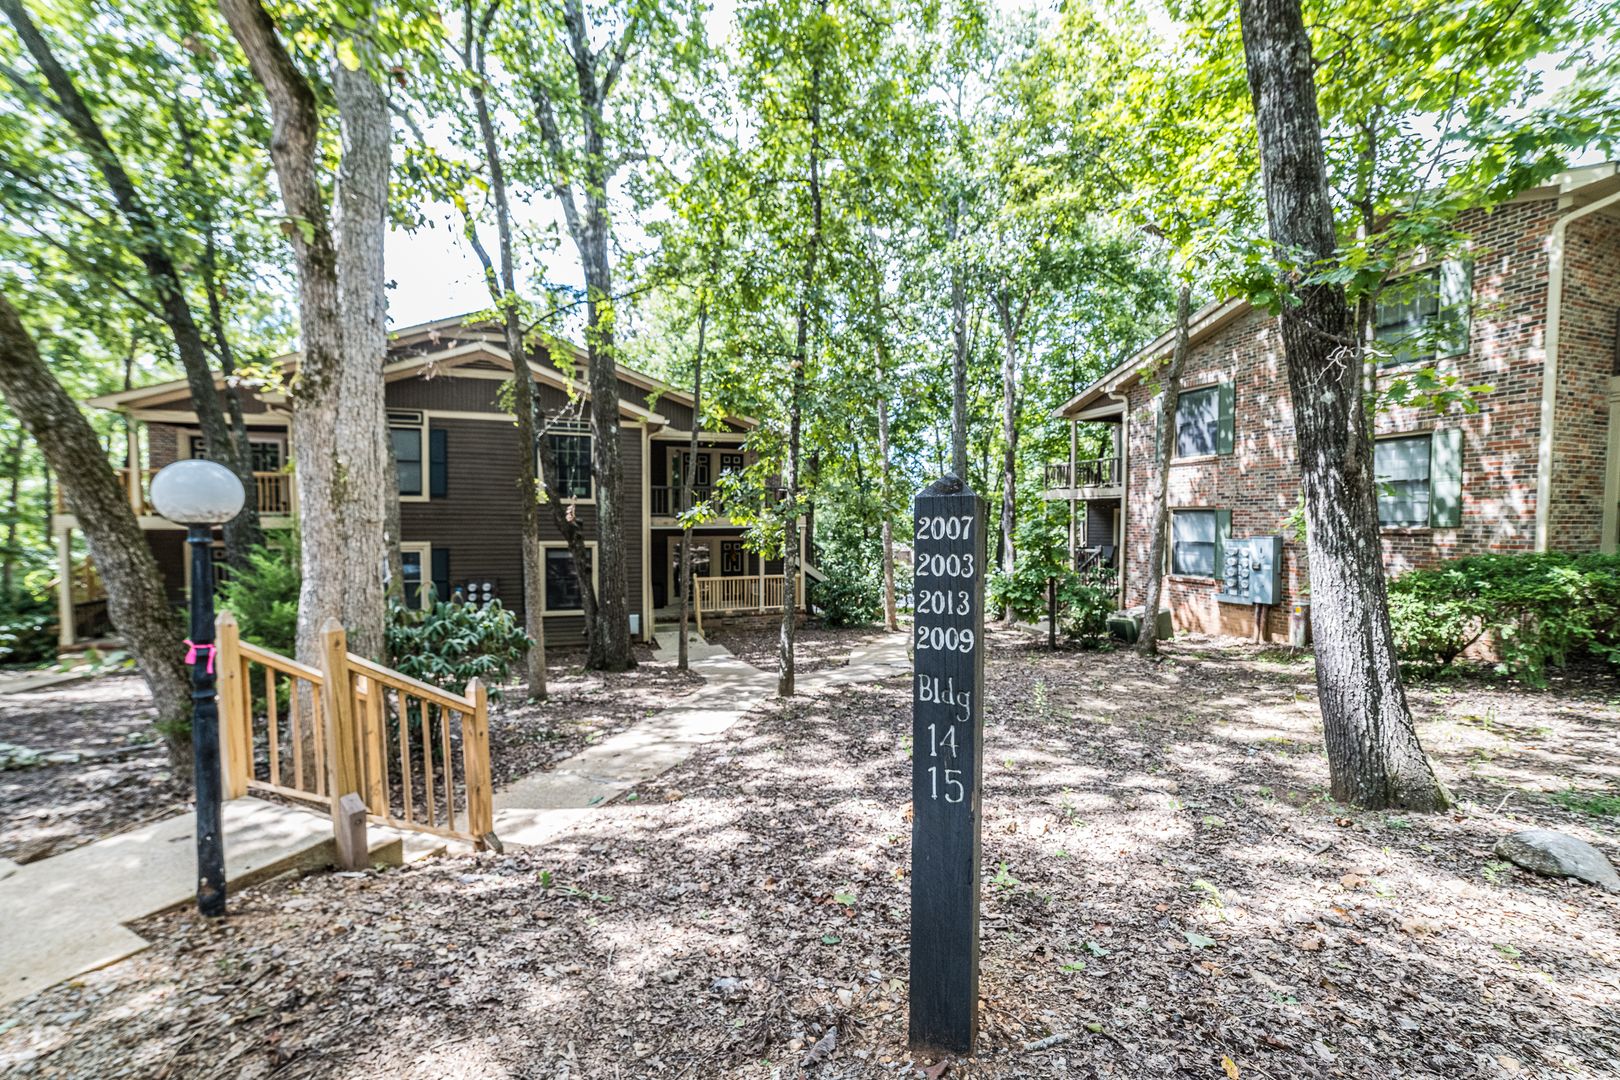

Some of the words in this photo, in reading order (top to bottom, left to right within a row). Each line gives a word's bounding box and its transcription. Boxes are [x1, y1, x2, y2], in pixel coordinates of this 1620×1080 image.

[916, 516, 974, 541] 2007
[916, 553, 974, 578] 2003
[917, 590, 970, 615] 2013
[917, 626, 974, 653] 2009
[918, 674, 971, 722] Bldg
[927, 723, 958, 758] 14
[927, 766, 965, 803] 15
